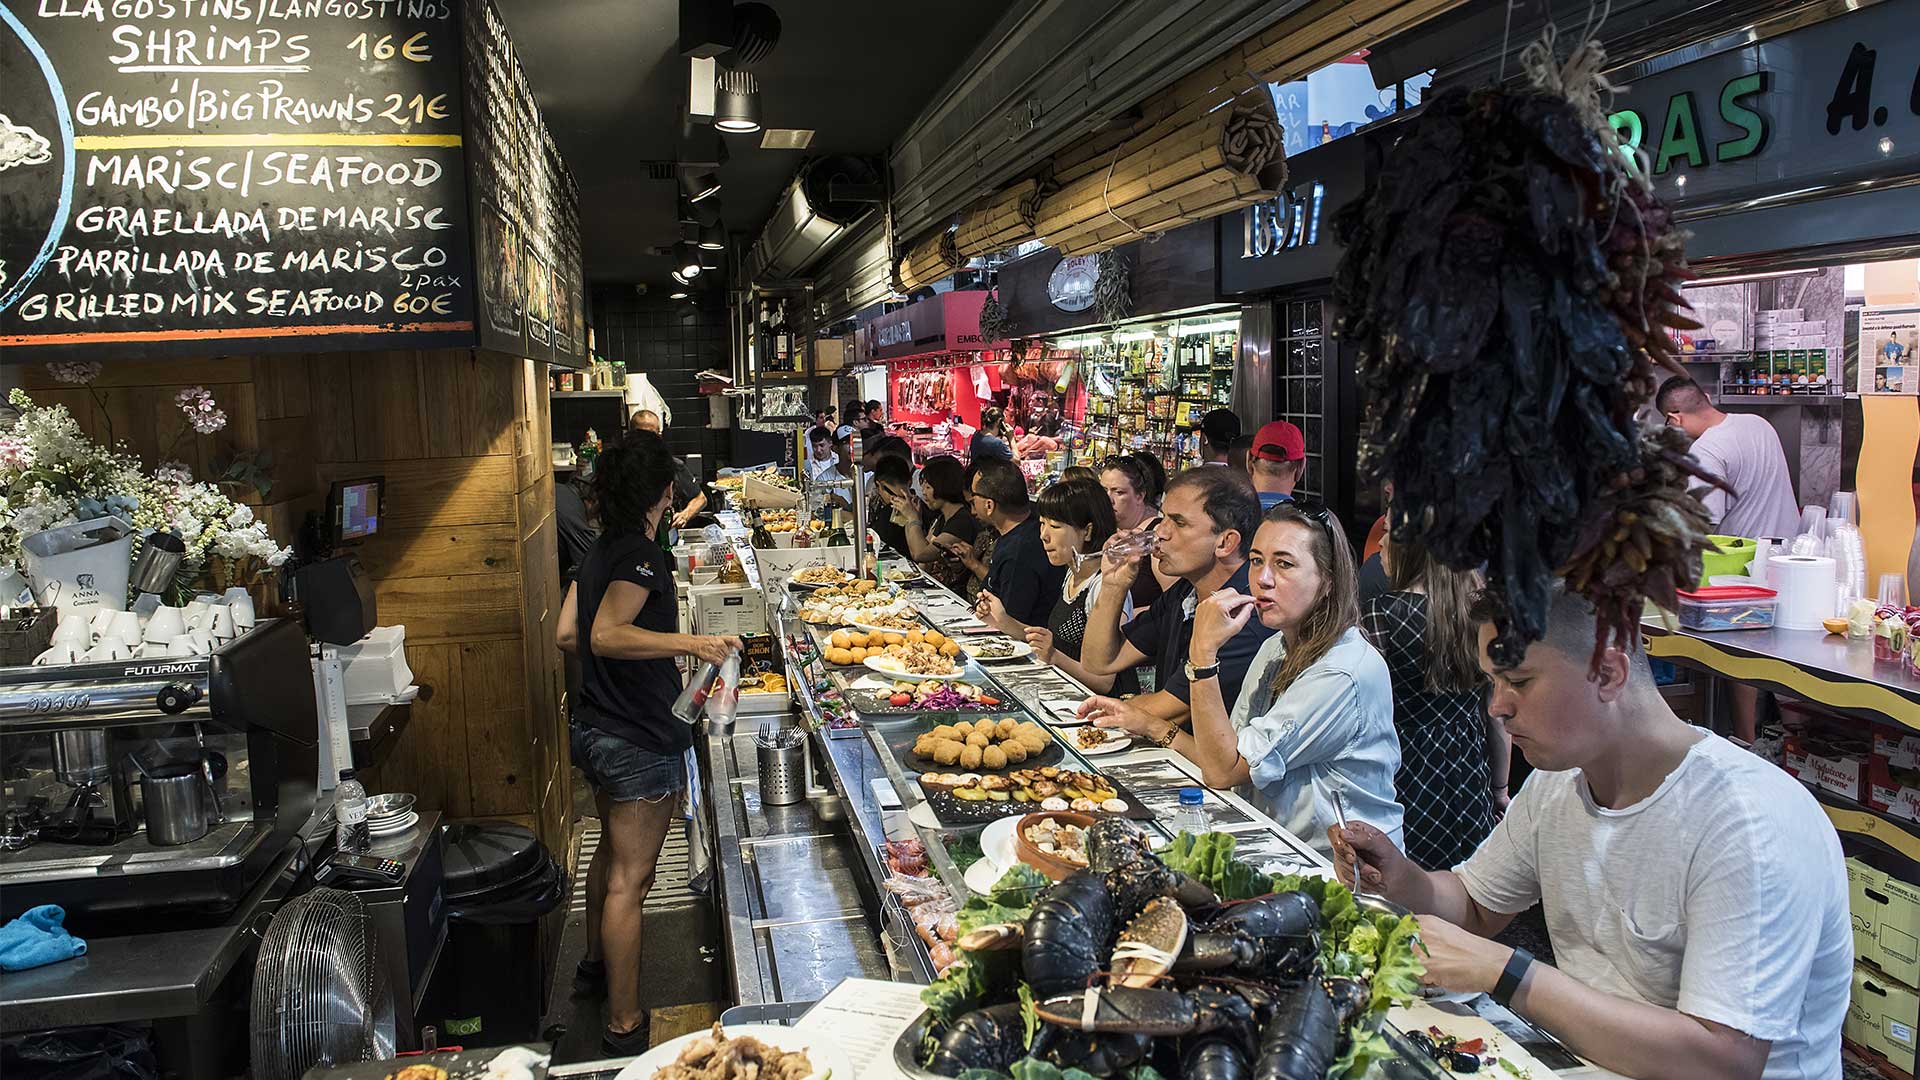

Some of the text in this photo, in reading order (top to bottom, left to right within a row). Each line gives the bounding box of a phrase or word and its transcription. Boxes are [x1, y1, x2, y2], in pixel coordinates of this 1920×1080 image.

[347, 31, 432, 62] 16€
[257, 80, 374, 125] PRAWNS
[377, 93, 449, 125] 21€
[76, 198, 454, 242] GRAELLADA DE MARISC
[50, 241, 446, 279] PARRILLADA DE MARISCO
[19, 288, 453, 321] GRILLED MIX SEAFOOD 60€
[72, 590, 100, 599] ANNA
[124, 663, 199, 676] FUTURMAT
